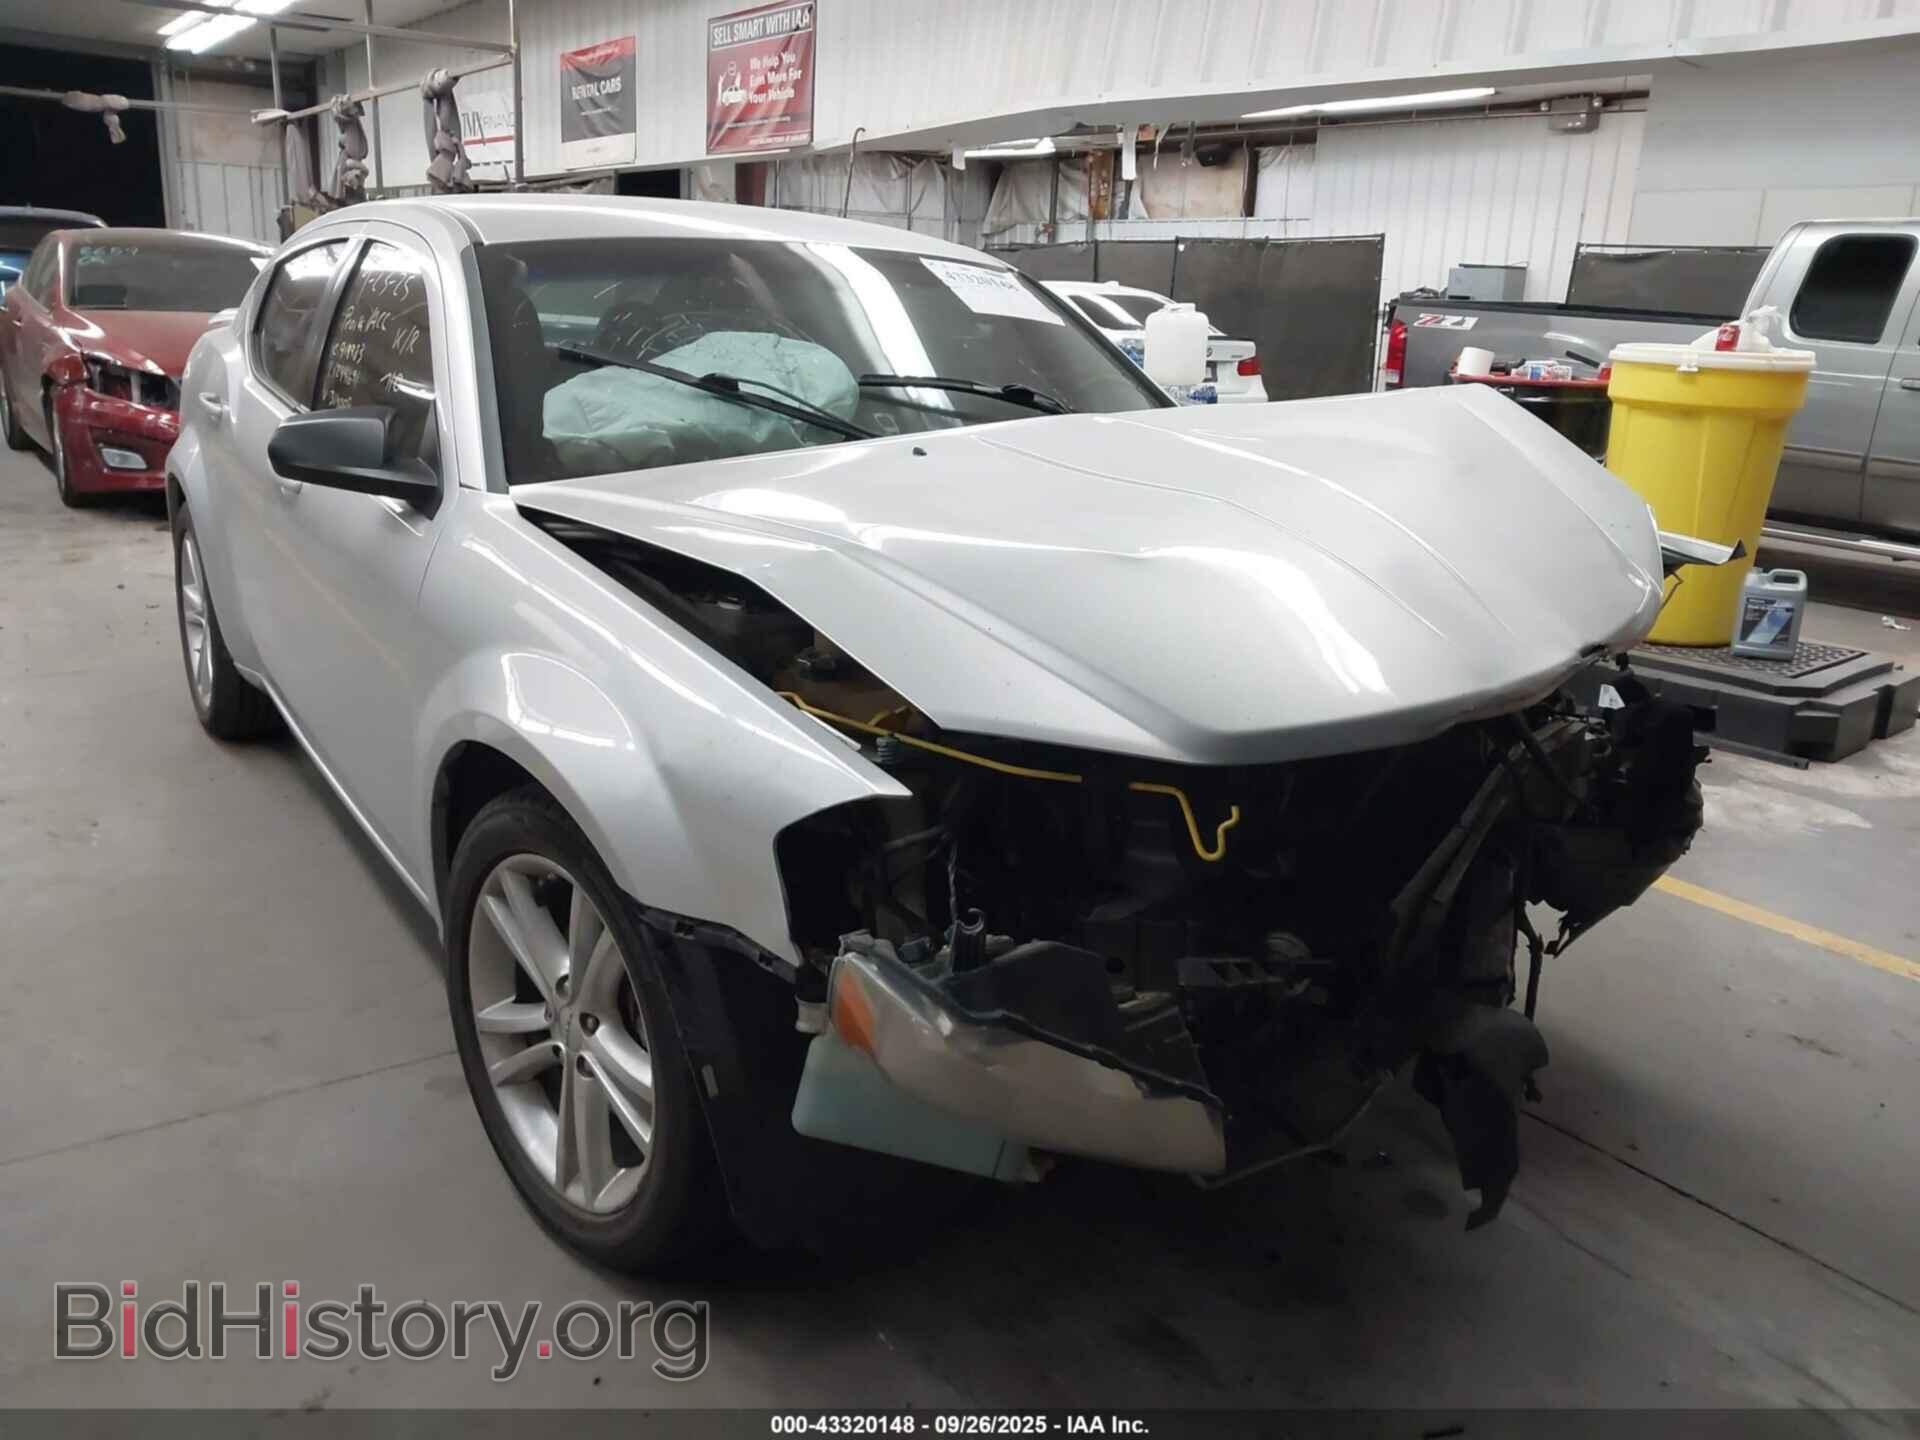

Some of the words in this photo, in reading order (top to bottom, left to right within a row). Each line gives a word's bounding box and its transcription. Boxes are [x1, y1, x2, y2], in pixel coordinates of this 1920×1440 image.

[713, 24, 732, 46] SELL
[734, 18, 765, 41] SMART
[765, 10, 790, 34] WITH
[781, 52, 796, 64] You
[788, 68, 803, 80] For
[600, 77, 622, 95] CARS
[749, 90, 767, 104] Your
